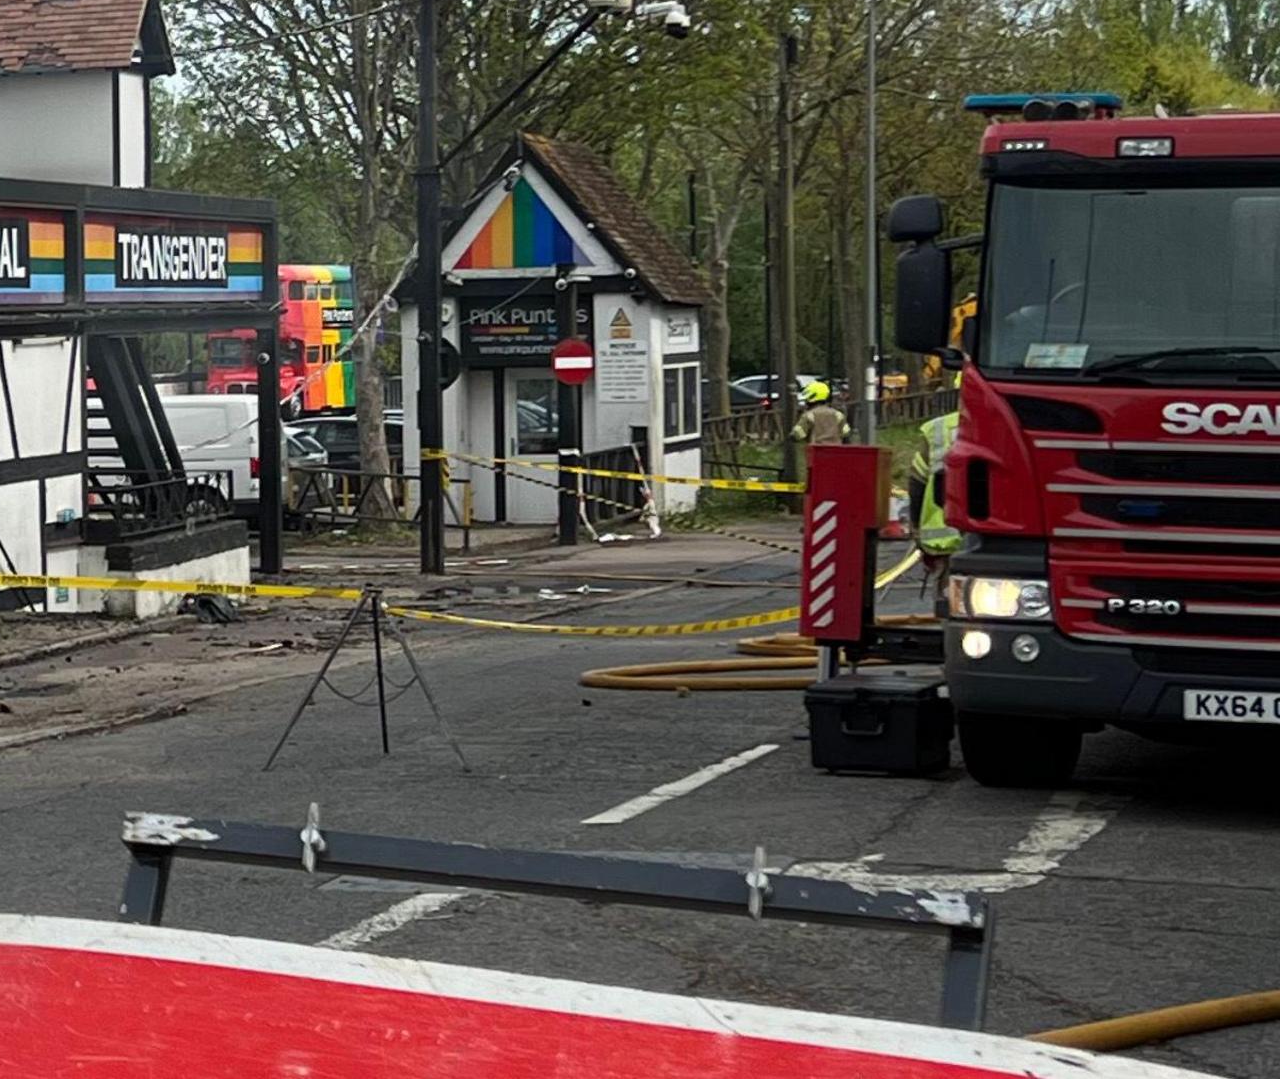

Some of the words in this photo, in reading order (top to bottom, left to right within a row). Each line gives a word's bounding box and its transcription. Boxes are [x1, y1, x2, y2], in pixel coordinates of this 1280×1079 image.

[117, 232, 228, 281] TRANSGENDER
[469, 308, 508, 325] Pink
[511, 308, 588, 324] Punts
[1108, 598, 1125, 613] P
[1128, 598, 1181, 615] 320
[1196, 693, 1265, 718] KX64
